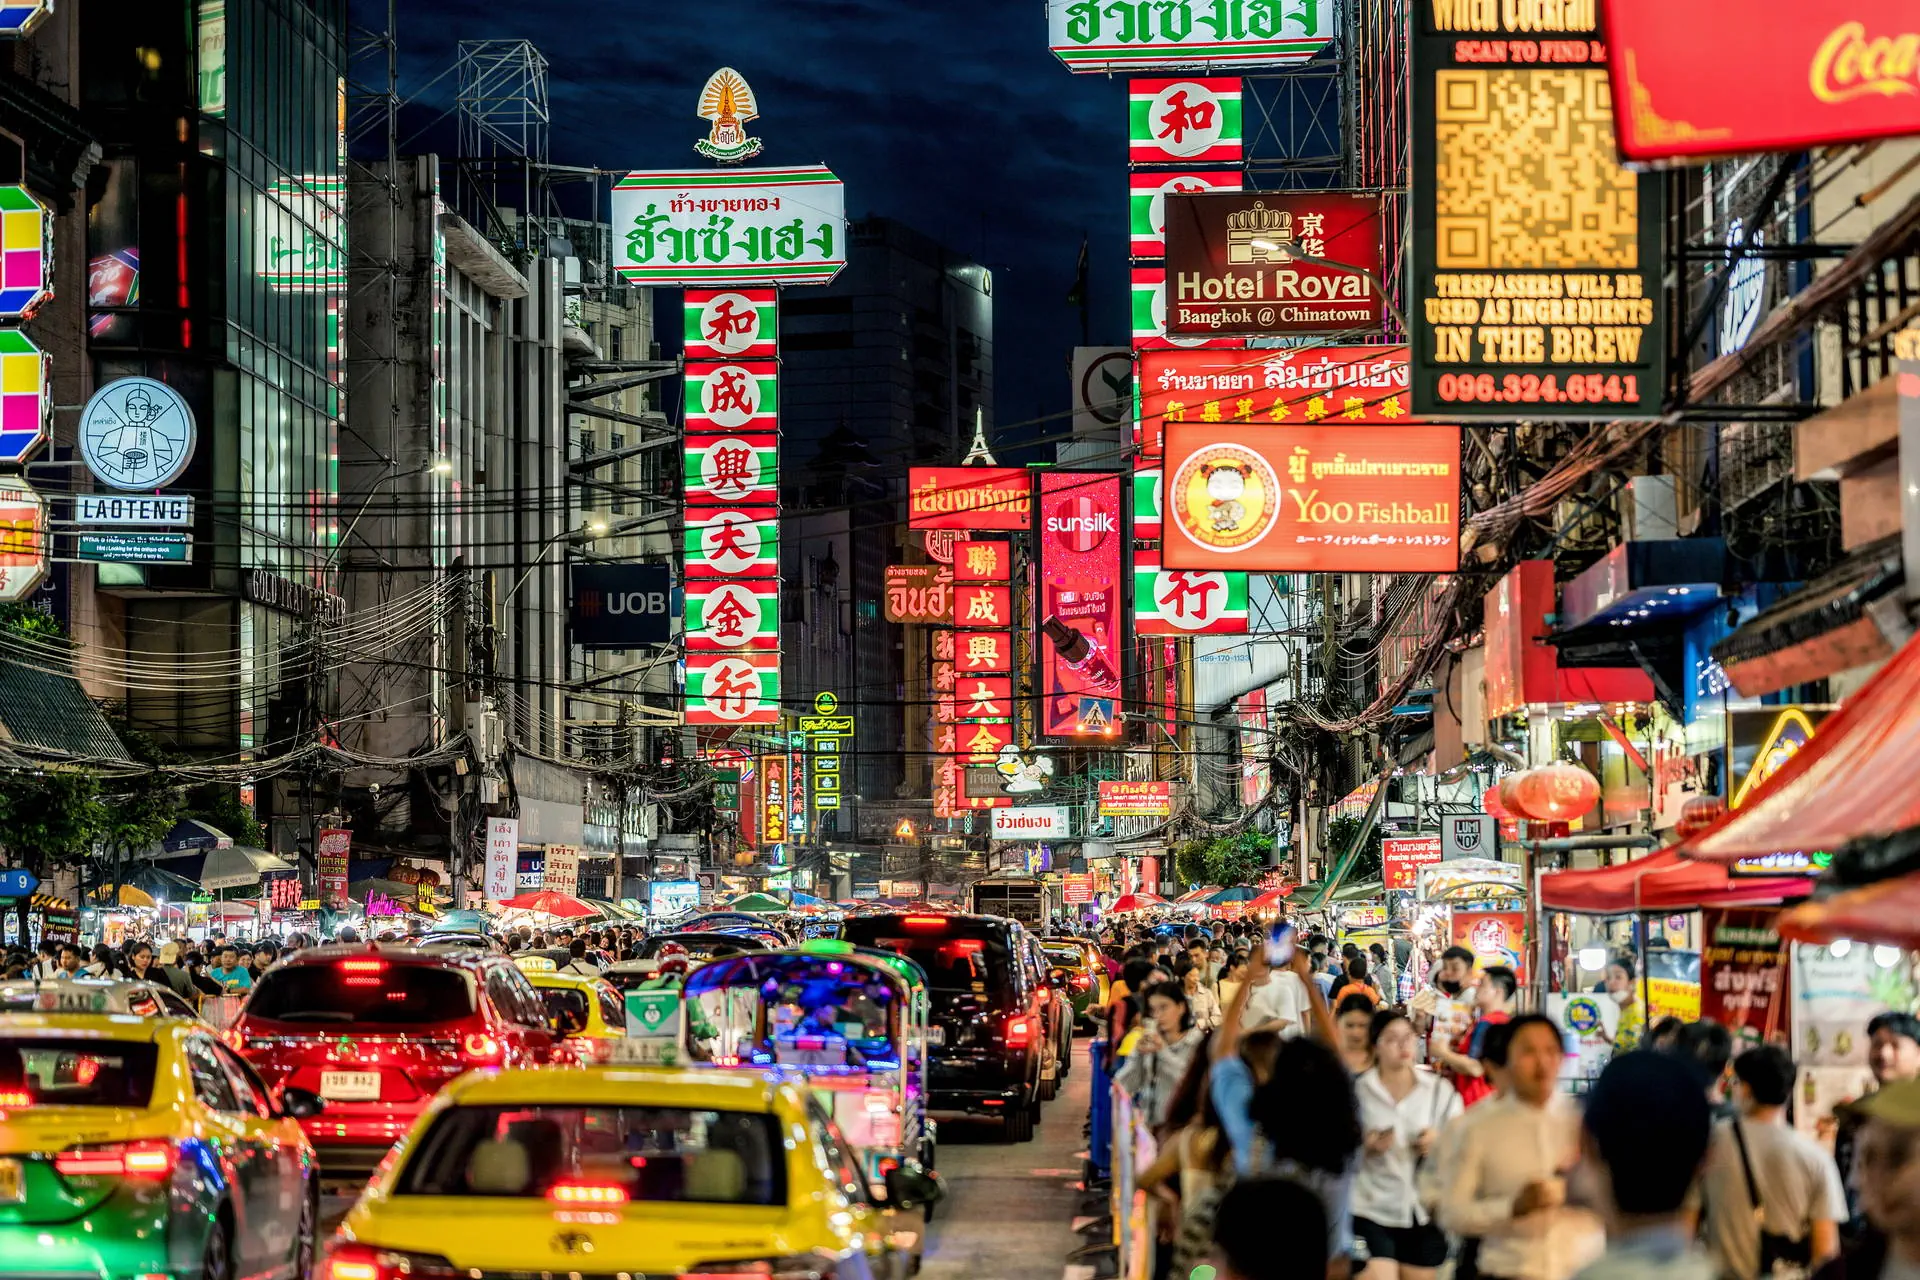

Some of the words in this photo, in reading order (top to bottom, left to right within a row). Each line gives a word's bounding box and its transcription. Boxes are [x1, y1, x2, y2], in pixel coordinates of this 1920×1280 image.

[1509, 40, 1538, 62] TO
[668, 192, 781, 213] ห้างขายทอง
[625, 203, 834, 263] ฮั่วเซ่งเฮง
[1178, 271, 1264, 300] Hotel
[1276, 269, 1371, 300] Royal
[1435, 274, 1563, 298] TRESPASSERS
[1564, 274, 1614, 298] WILL
[1616, 274, 1643, 298] BE
[1179, 308, 1253, 328] Bangkok
[1280, 307, 1371, 322] Chinatown
[1424, 298, 1480, 325] USED
[1481, 298, 1511, 325] AS
[1511, 298, 1653, 325] INGREDIENTS
[1434, 326, 1473, 363] IN
[1477, 326, 1545, 363] THE
[1550, 326, 1643, 363] BREW
[1157, 368, 1253, 391] ร้านขายยา
[1437, 373, 1640, 402] 096.324.6541
[84, 499, 183, 520] LAOTENG
[1357, 501, 1450, 524] Fishball
[1047, 513, 1115, 532] sunsilk
[253, 569, 278, 604] GOLD
[607, 592, 666, 615] UOB
[1456, 821, 1479, 833] LUMI
[1456, 835, 1479, 849] NOX
[18, 875, 28, 889] 9
